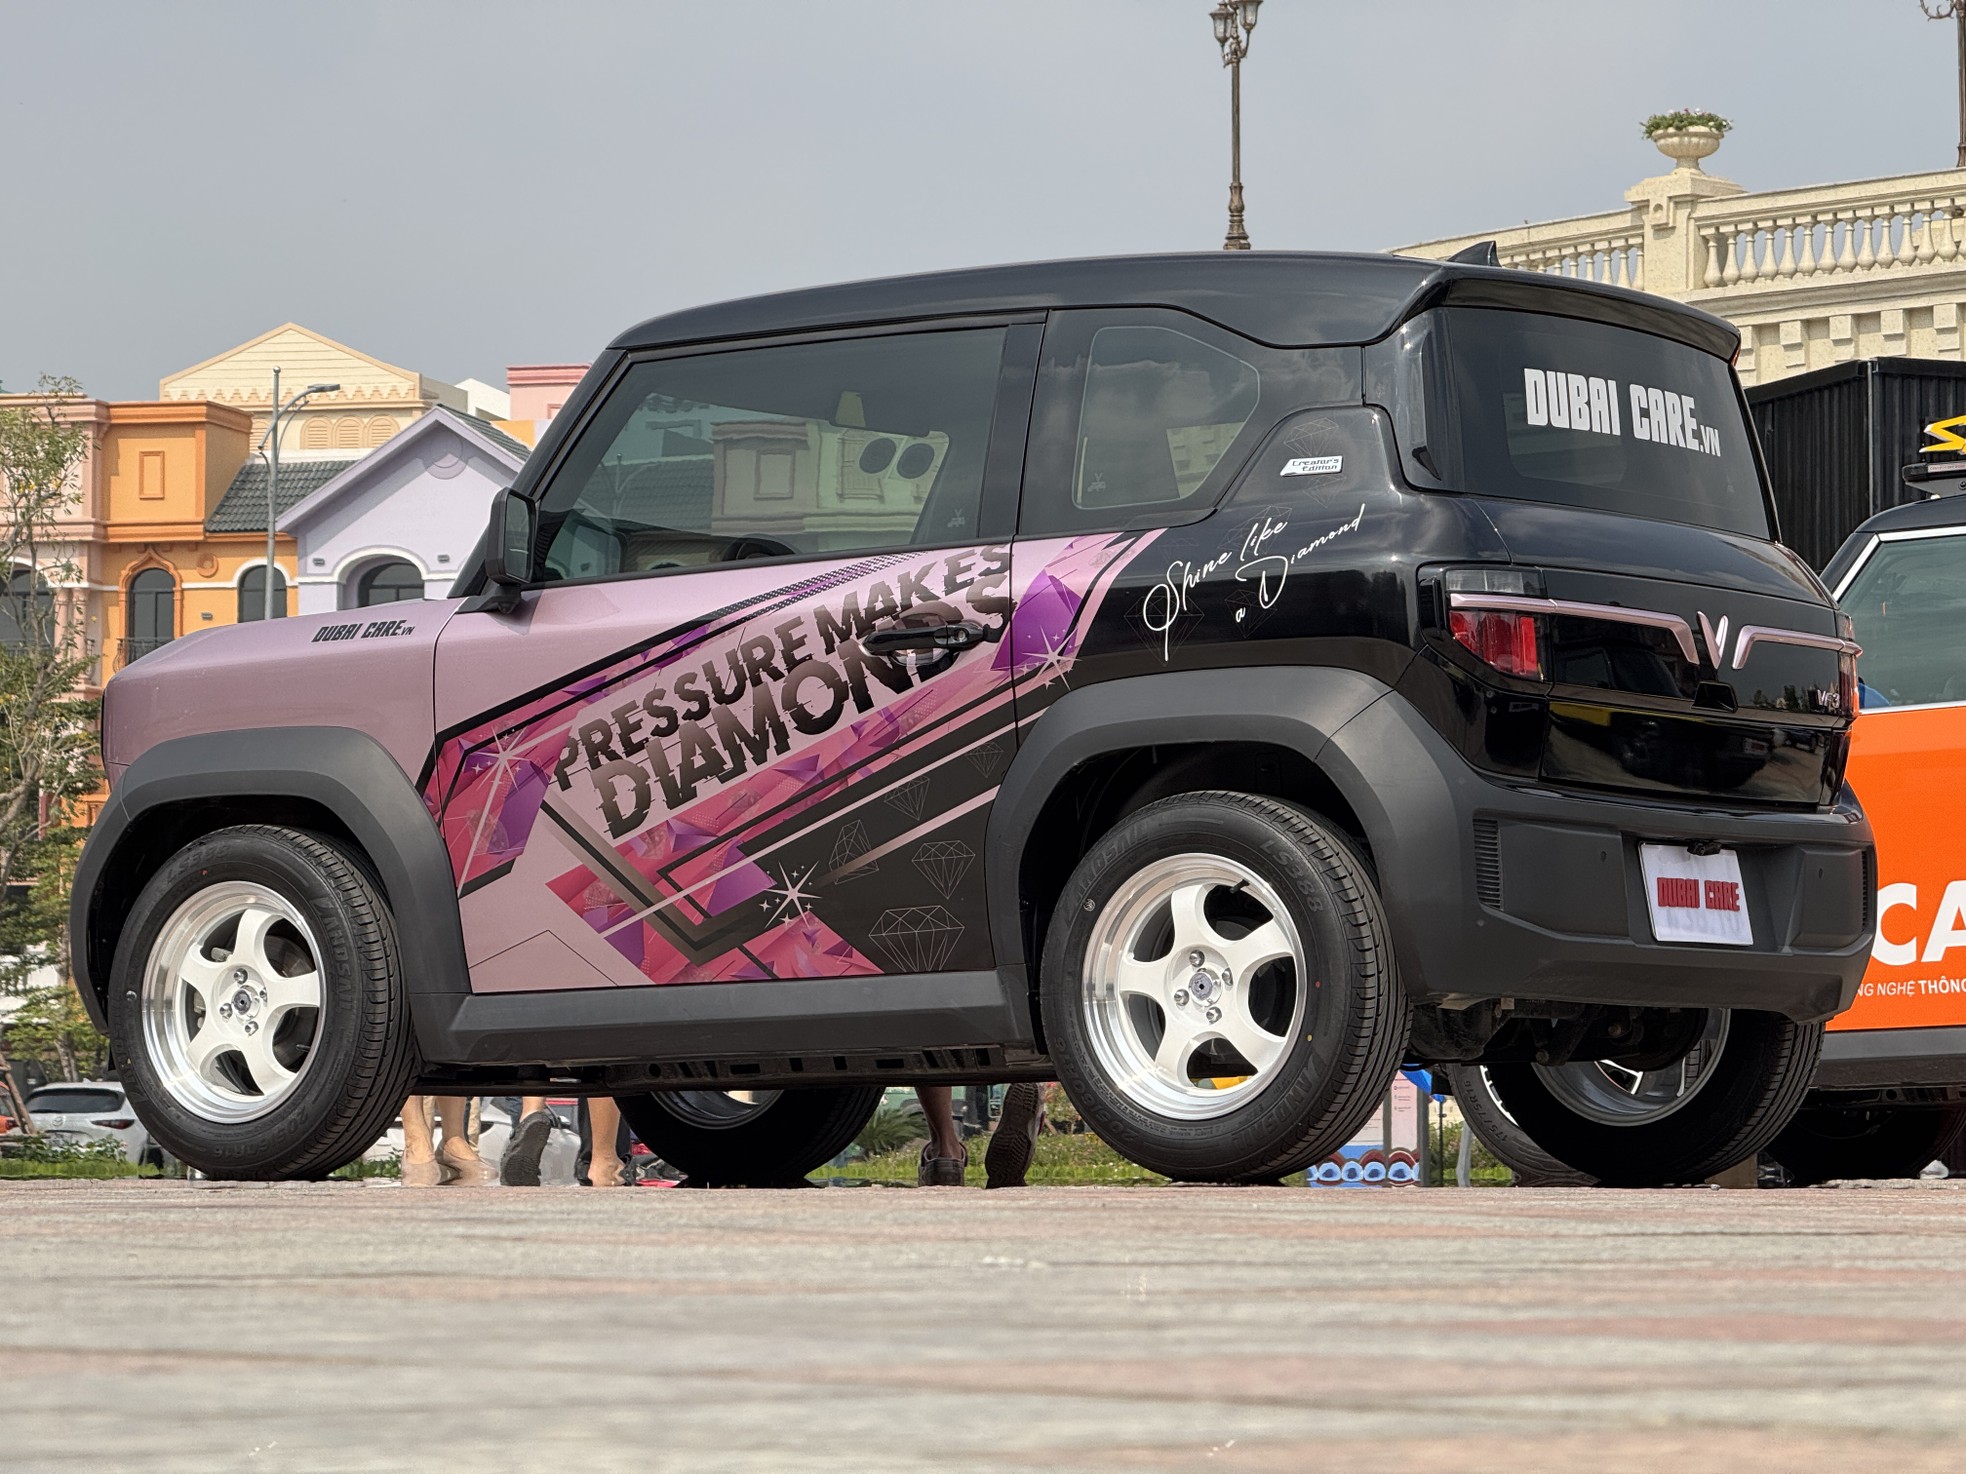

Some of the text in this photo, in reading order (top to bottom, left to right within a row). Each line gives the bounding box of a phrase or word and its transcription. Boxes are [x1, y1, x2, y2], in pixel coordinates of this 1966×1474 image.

[1524, 368, 1721, 457] DUBAI CARE.VN
[1143, 517, 1288, 662] Shine like
[1235, 503, 1365, 609] Diamond
[311, 623, 364, 643] DUBAI
[552, 543, 1013, 792] PRESSURE MAKES
[1657, 877, 1740, 912] DUBAI CARE
[1877, 980, 1916, 997] NGHỆ
